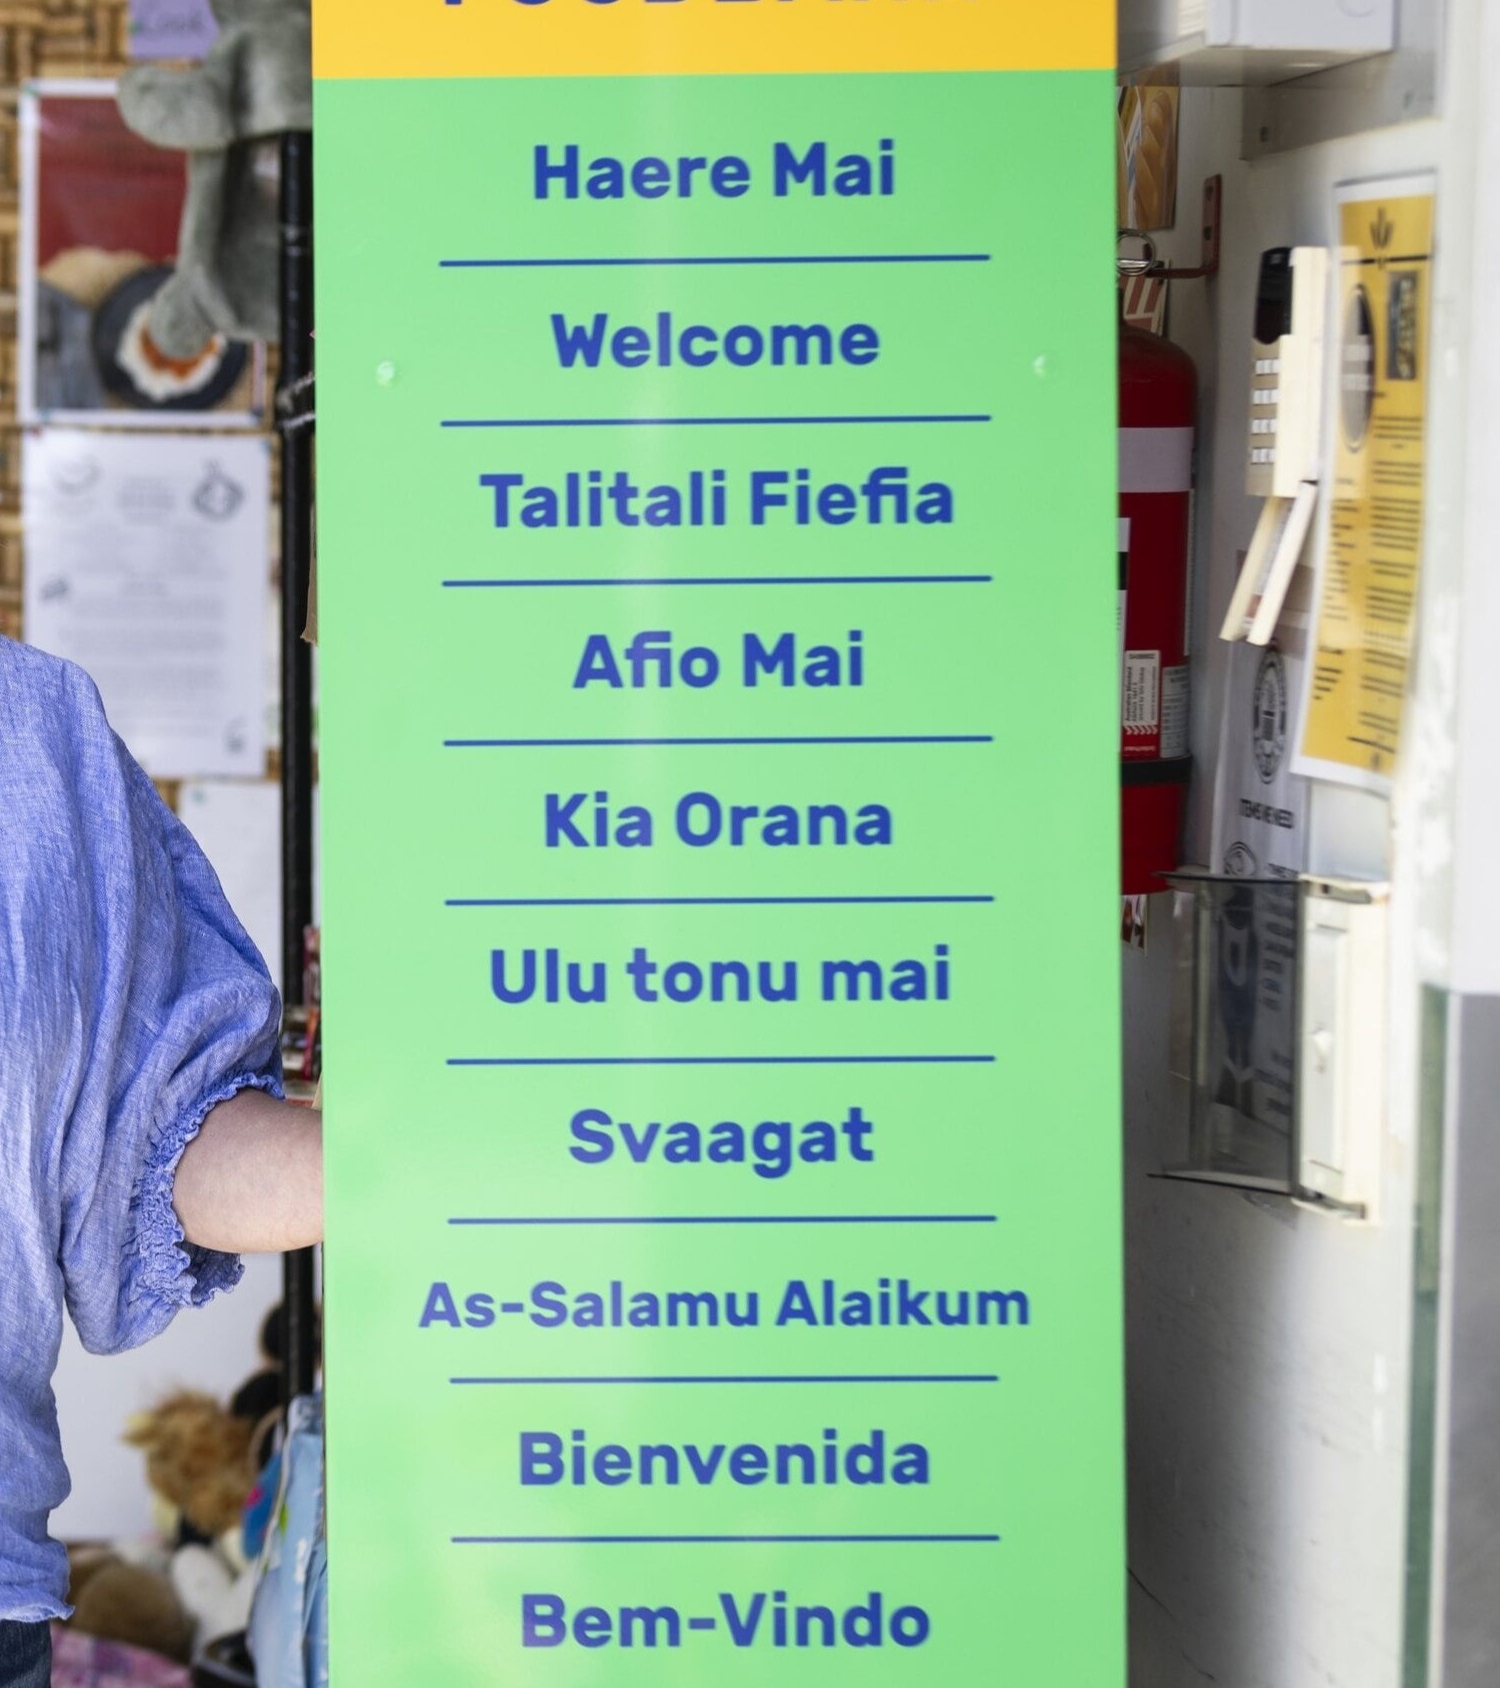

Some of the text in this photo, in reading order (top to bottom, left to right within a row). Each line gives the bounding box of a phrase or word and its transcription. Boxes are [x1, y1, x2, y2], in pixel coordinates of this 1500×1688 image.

[533, 138, 895, 201] Haere Mai
[550, 311, 881, 369] Welcome
[478, 466, 955, 530] Talitali Fiefia
[572, 629, 864, 690] Afio Mai
[543, 790, 893, 849] Kia Orana
[489, 943, 950, 1006] Ulu tonu mai
[568, 1107, 875, 1180] Svaagat
[418, 1278, 1030, 1329] As-Salamu Alaikum
[519, 1428, 930, 1487] Bienvenida
[520, 1590, 931, 1649] Bem-Vindo
